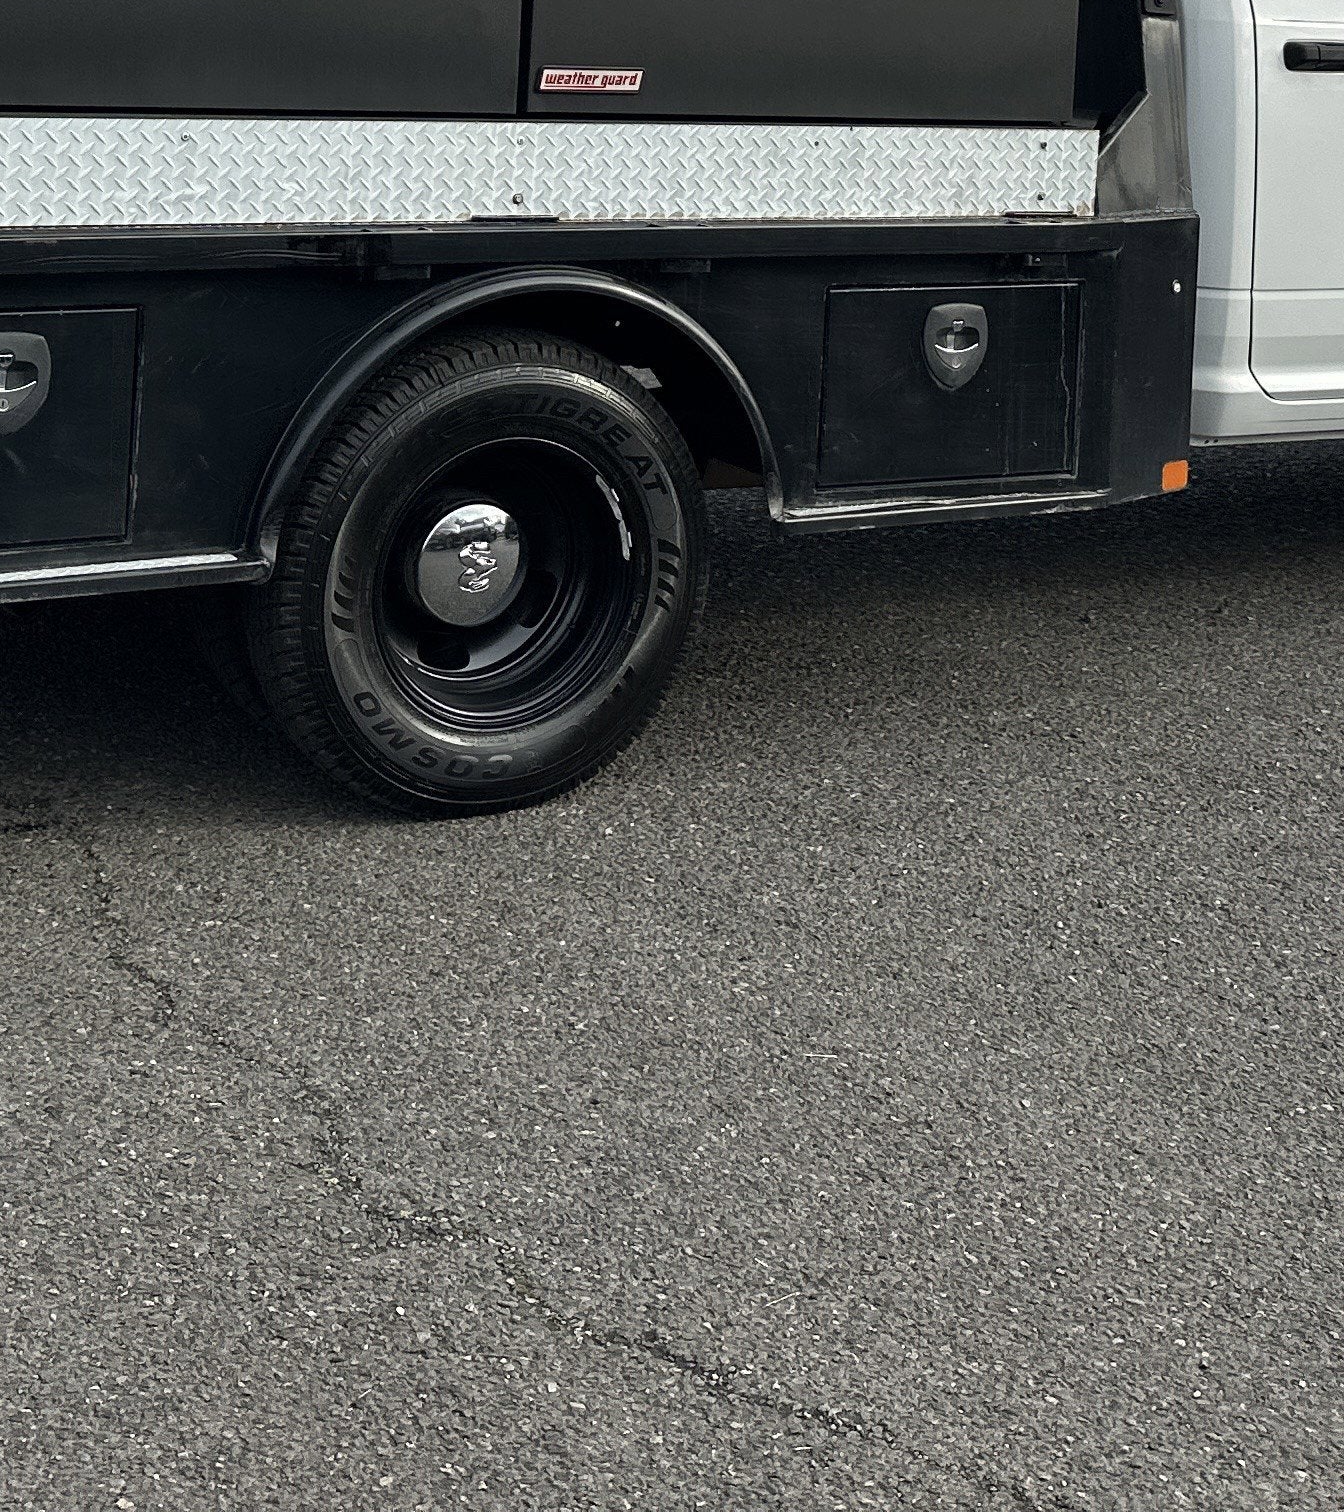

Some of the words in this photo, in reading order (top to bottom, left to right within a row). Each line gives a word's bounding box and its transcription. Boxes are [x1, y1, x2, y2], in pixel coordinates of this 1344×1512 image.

[544, 72, 599, 85] weather
[600, 72, 638, 88] guard
[354, 691, 512, 781] COSMO
